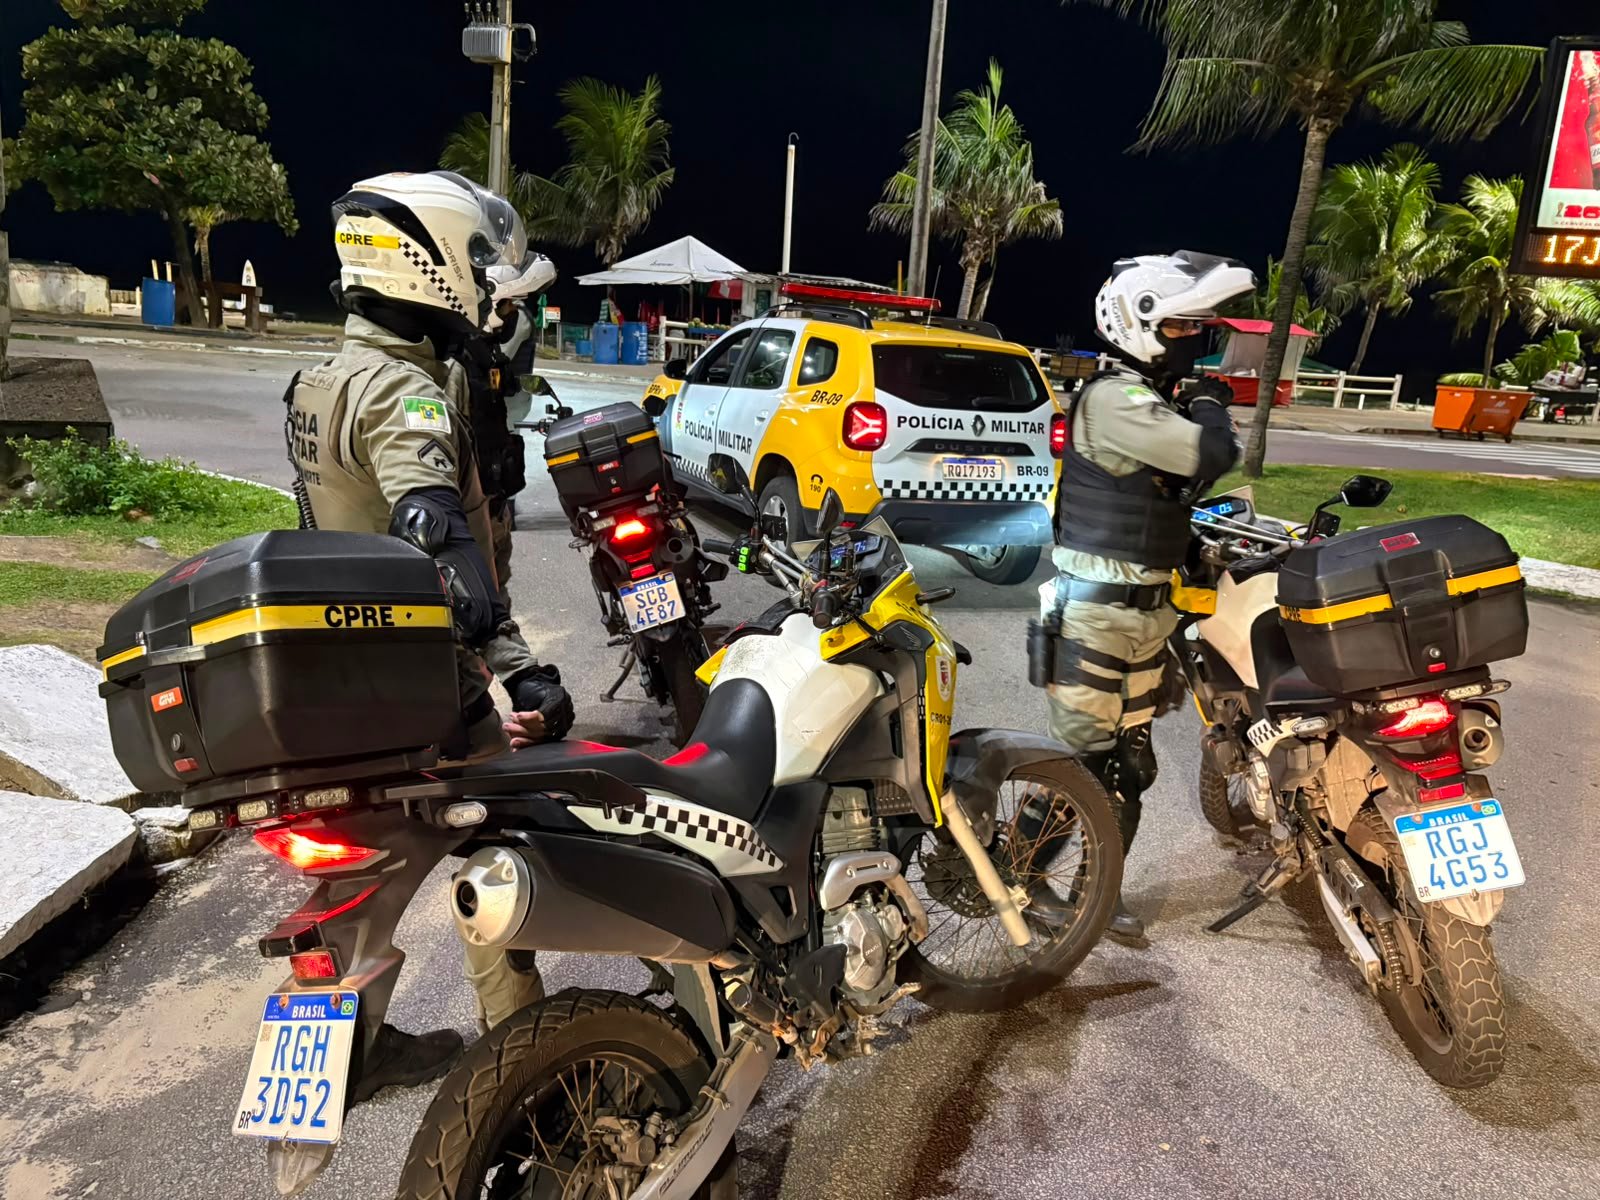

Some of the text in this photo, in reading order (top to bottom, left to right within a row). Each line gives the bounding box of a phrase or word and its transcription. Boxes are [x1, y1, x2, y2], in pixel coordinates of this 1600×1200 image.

[340, 232, 374, 246] CPRE
[440, 236, 465, 283] NORISK
[810, 389, 843, 406] BR-09
[295, 409, 319, 438] CIA
[897, 413, 1045, 434] POLÍCIA MILITAR
[684, 419, 753, 455] POLÍCIA MILITAR
[294, 434, 319, 465] TAR
[1017, 465, 1049, 477] BR-09
[809, 483, 821, 493] 190
[635, 586, 668, 609] SCB
[324, 605, 396, 628] CPRE
[636, 600, 676, 626] 4E87
[1428, 812, 1470, 827] BRASIL
[1425, 822, 1489, 859] RGJ
[1429, 850, 1509, 890] 4G53
[1418, 886, 1431, 898] BR
[291, 1004, 327, 1019] BRASIL
[270, 1024, 332, 1073] RGH
[251, 1076, 332, 1128] 3D52
[238, 1110, 251, 1130] BR
